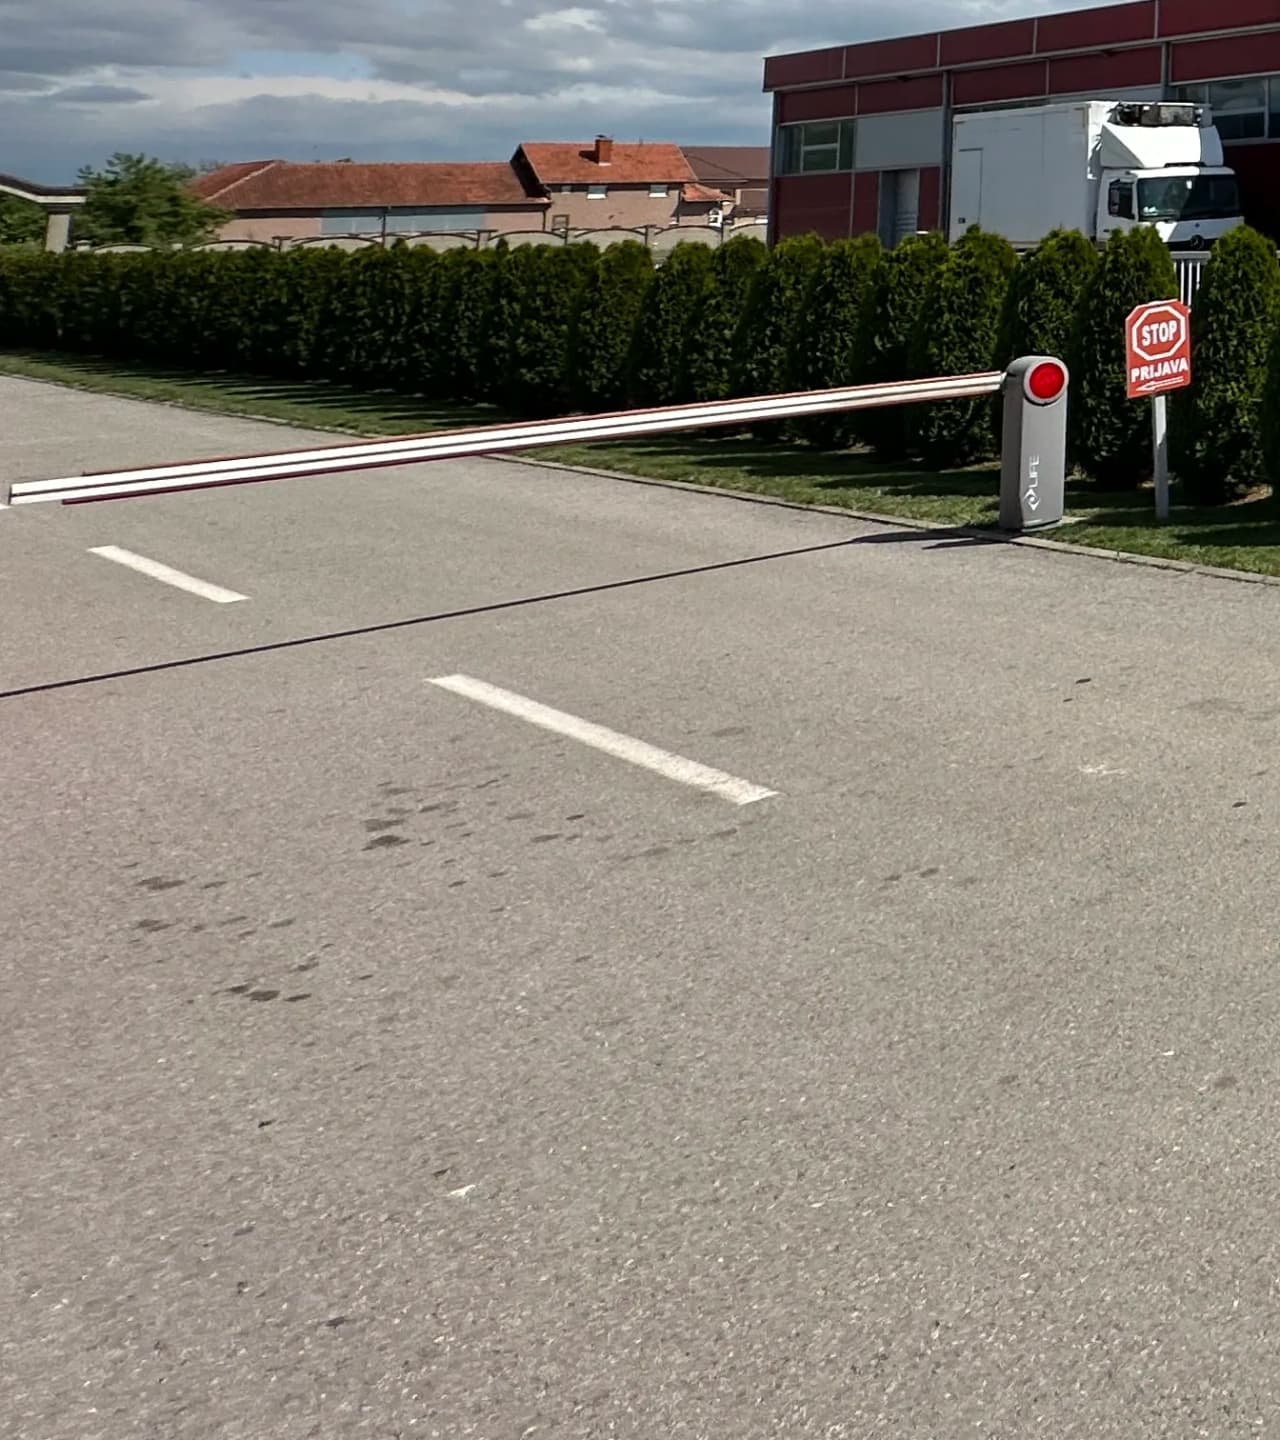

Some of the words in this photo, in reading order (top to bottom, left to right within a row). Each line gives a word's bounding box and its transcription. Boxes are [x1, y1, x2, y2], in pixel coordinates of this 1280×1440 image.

[1142, 320, 1178, 347] STOP
[1131, 357, 1189, 383] PRIJAVA
[1028, 455, 1040, 488] LIFE
